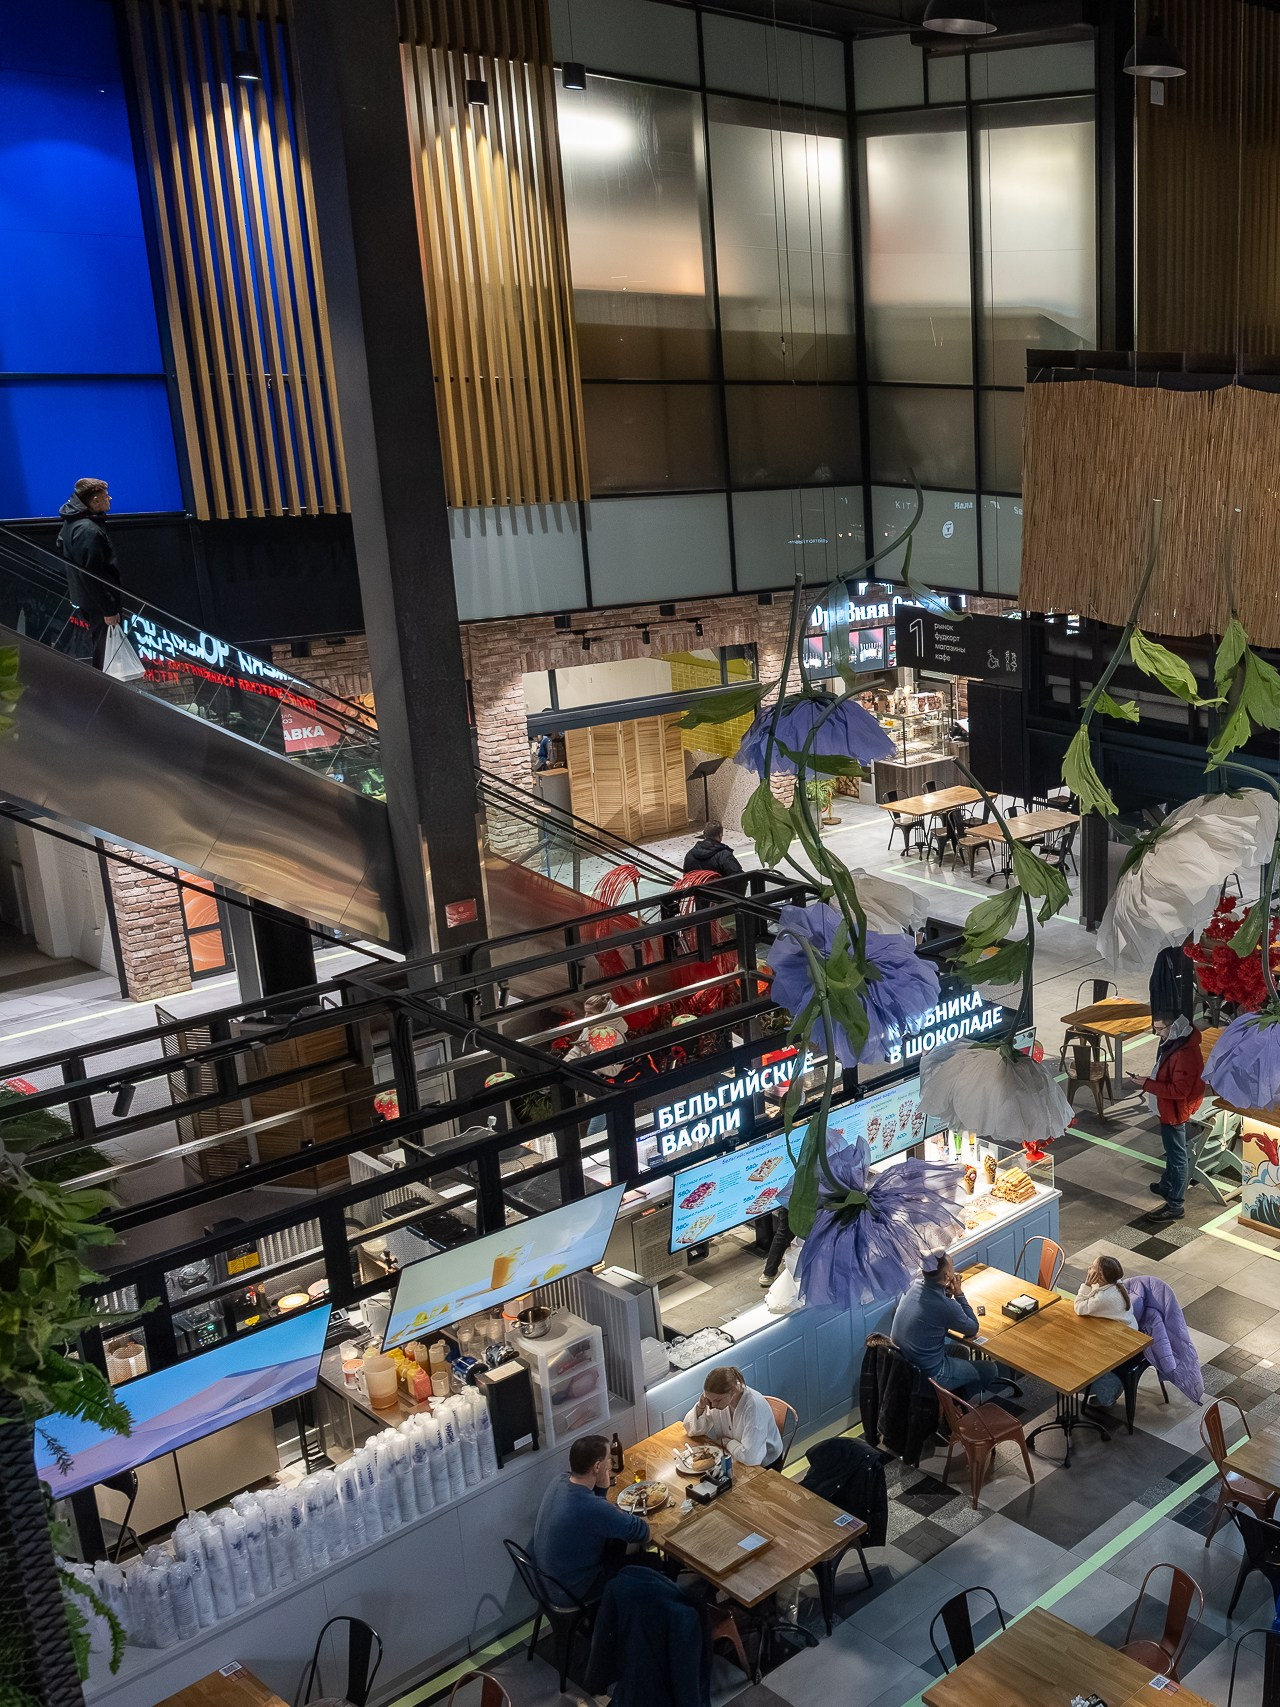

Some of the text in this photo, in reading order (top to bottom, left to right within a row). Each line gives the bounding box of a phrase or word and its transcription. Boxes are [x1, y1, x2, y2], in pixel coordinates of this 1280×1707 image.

[909, 618, 924, 657] 1
[934, 623, 954, 631] рынок
[934, 633, 960, 643] фудкорт
[935, 644, 966, 654] магазины
[935, 653, 951, 662] кафе
[888, 991, 983, 1041] КБНИКА
[890, 1005, 1003, 1064] В ШОКОЛАДЕ
[657, 1051, 815, 1130] БЕЛЬГИЙСКИЕ
[661, 1108, 741, 1156] ВАФЛИ
